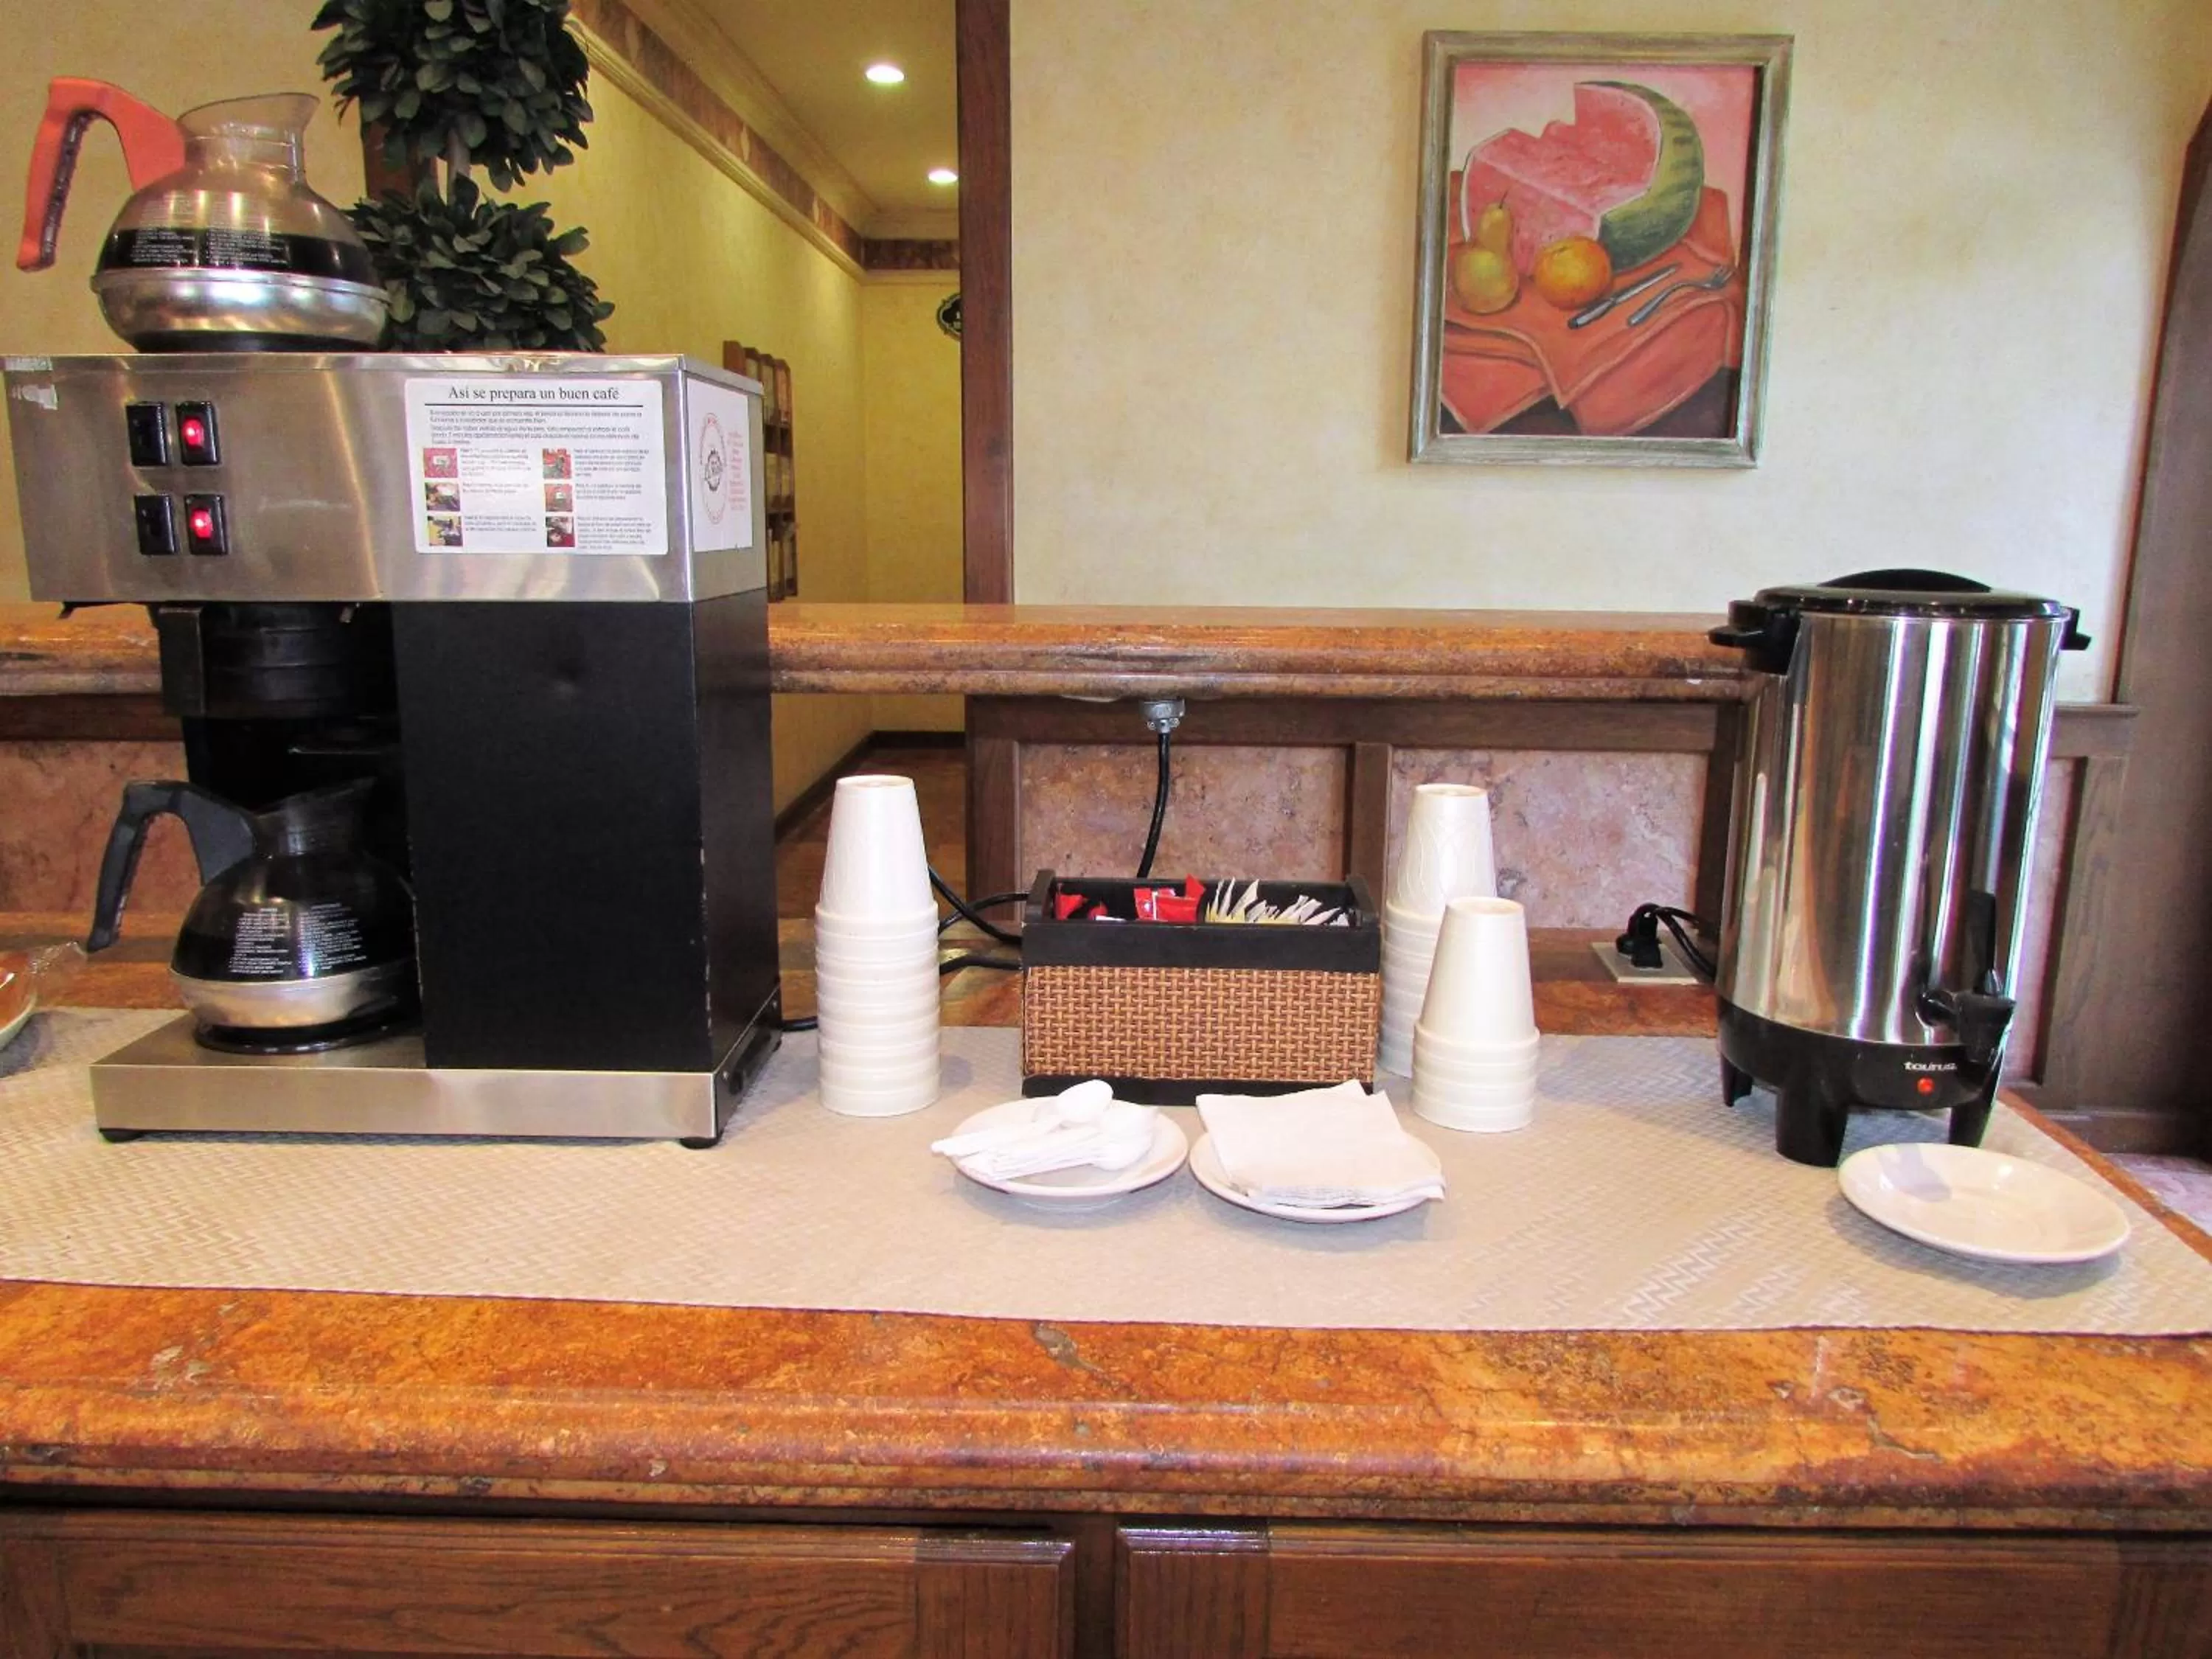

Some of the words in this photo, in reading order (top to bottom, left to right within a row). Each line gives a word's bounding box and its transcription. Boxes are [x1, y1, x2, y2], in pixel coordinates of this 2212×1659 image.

[473, 389, 486, 399] se
[490, 389, 536, 402] prepara
[540, 389, 555, 399] un
[559, 386, 589, 399] buen
